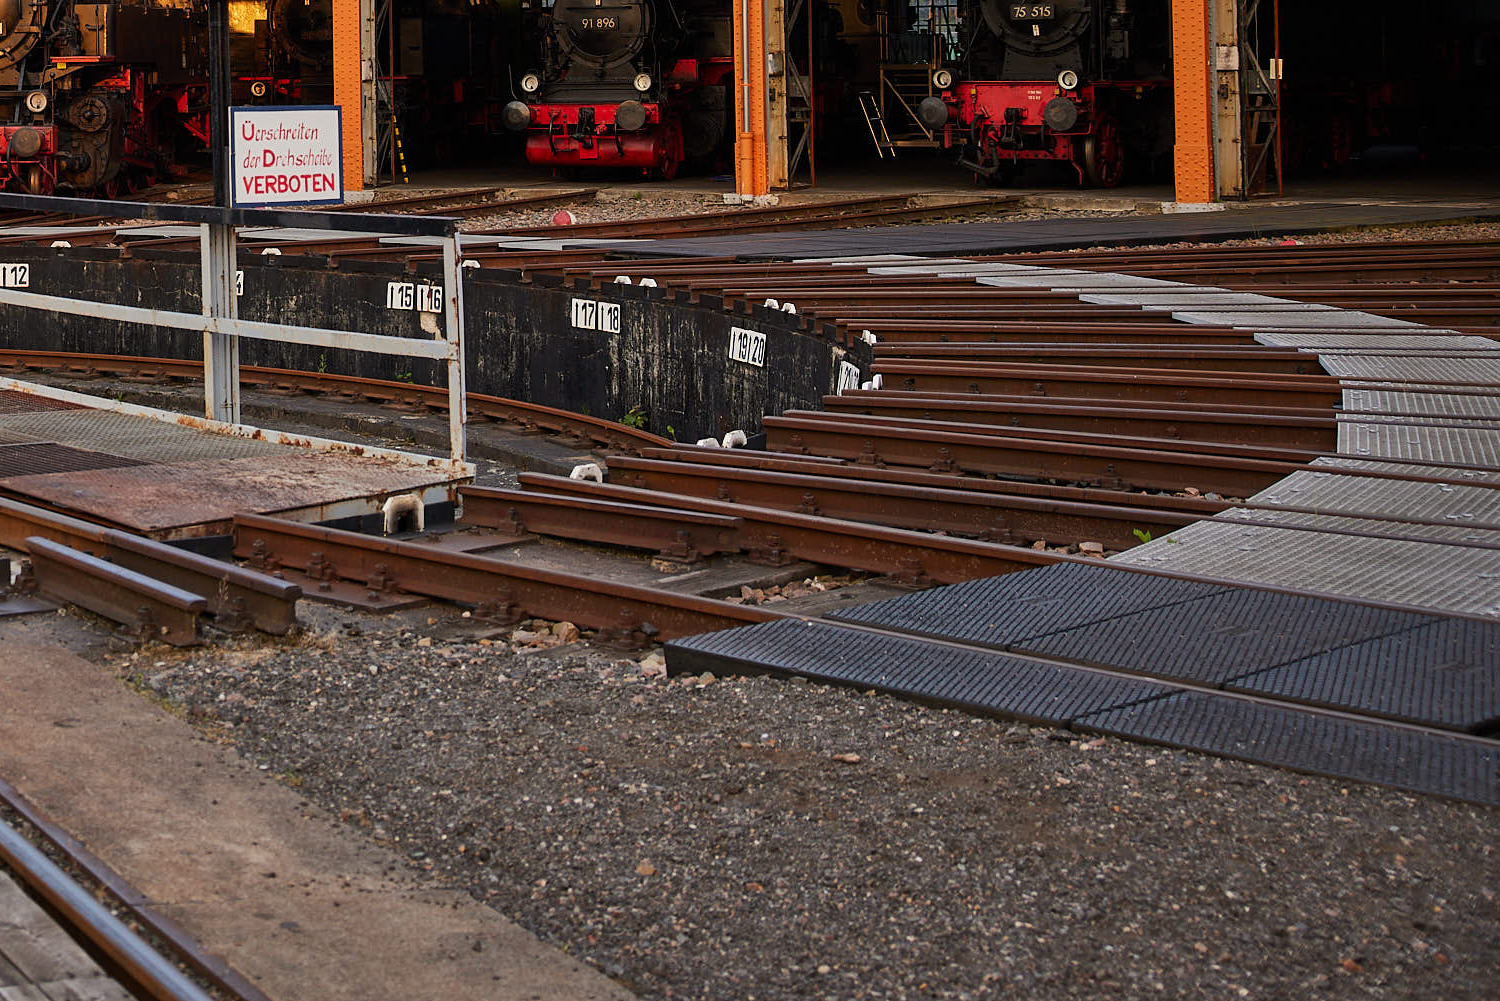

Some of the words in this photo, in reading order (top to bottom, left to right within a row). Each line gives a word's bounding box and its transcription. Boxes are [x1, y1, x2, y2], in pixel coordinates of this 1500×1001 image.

[582, 18, 593, 29] 91
[596, 17, 616, 28] 896
[1013, 6, 1027, 18] 75
[1031, 6, 1051, 17] 515
[243, 149, 261, 168] der
[243, 173, 335, 194] VERBOTEN
[10, 265, 27, 286] 12
[397, 285, 412, 308] 15
[426, 288, 441, 311] 16
[581, 302, 595, 327] 17
[607, 306, 619, 331] 18
[738, 332, 748, 360] 19
[751, 336, 765, 364] 20
